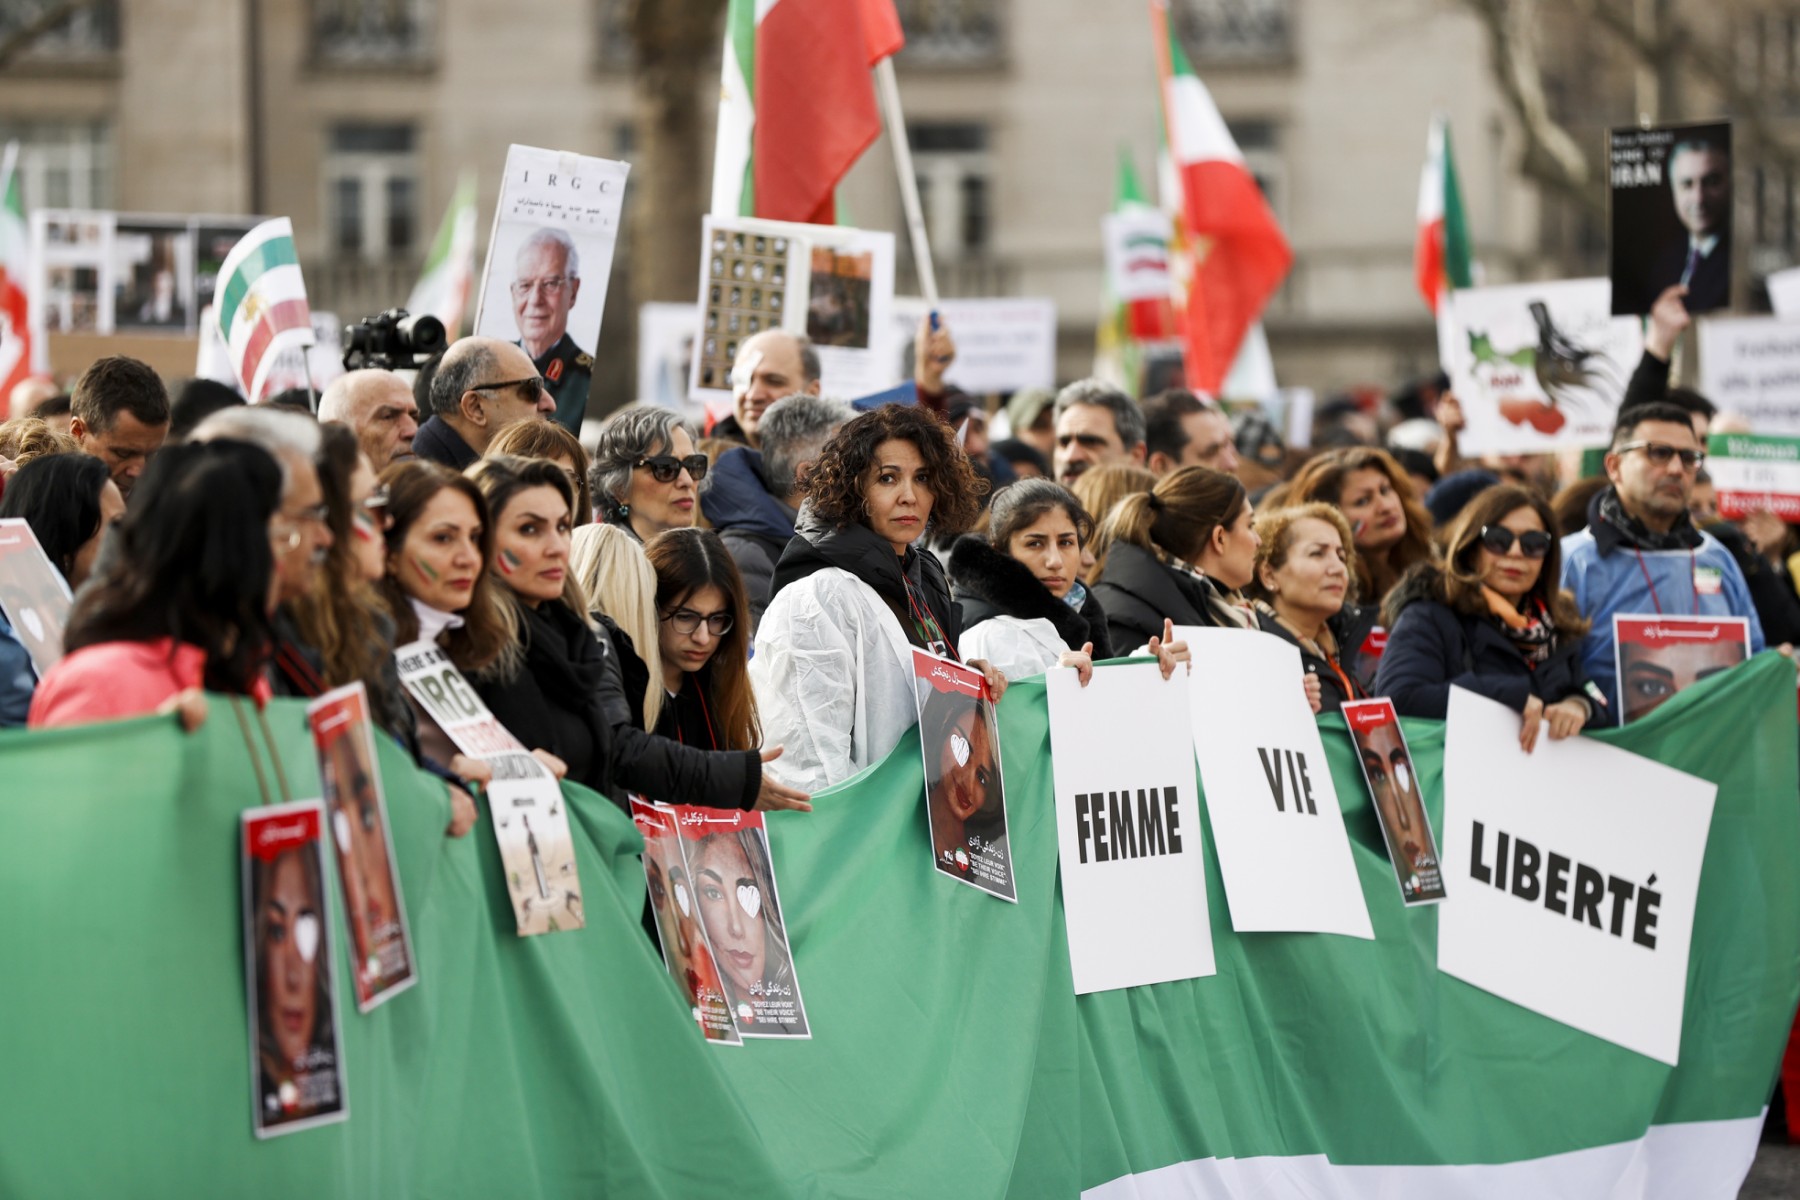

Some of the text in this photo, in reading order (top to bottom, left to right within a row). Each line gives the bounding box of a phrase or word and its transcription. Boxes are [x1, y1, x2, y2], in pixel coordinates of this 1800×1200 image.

[1611, 162, 1662, 189] IRAN
[1257, 747, 1318, 816] VIE
[1075, 786, 1183, 864] FEMME
[1470, 819, 1662, 951] LIBERTÉ
